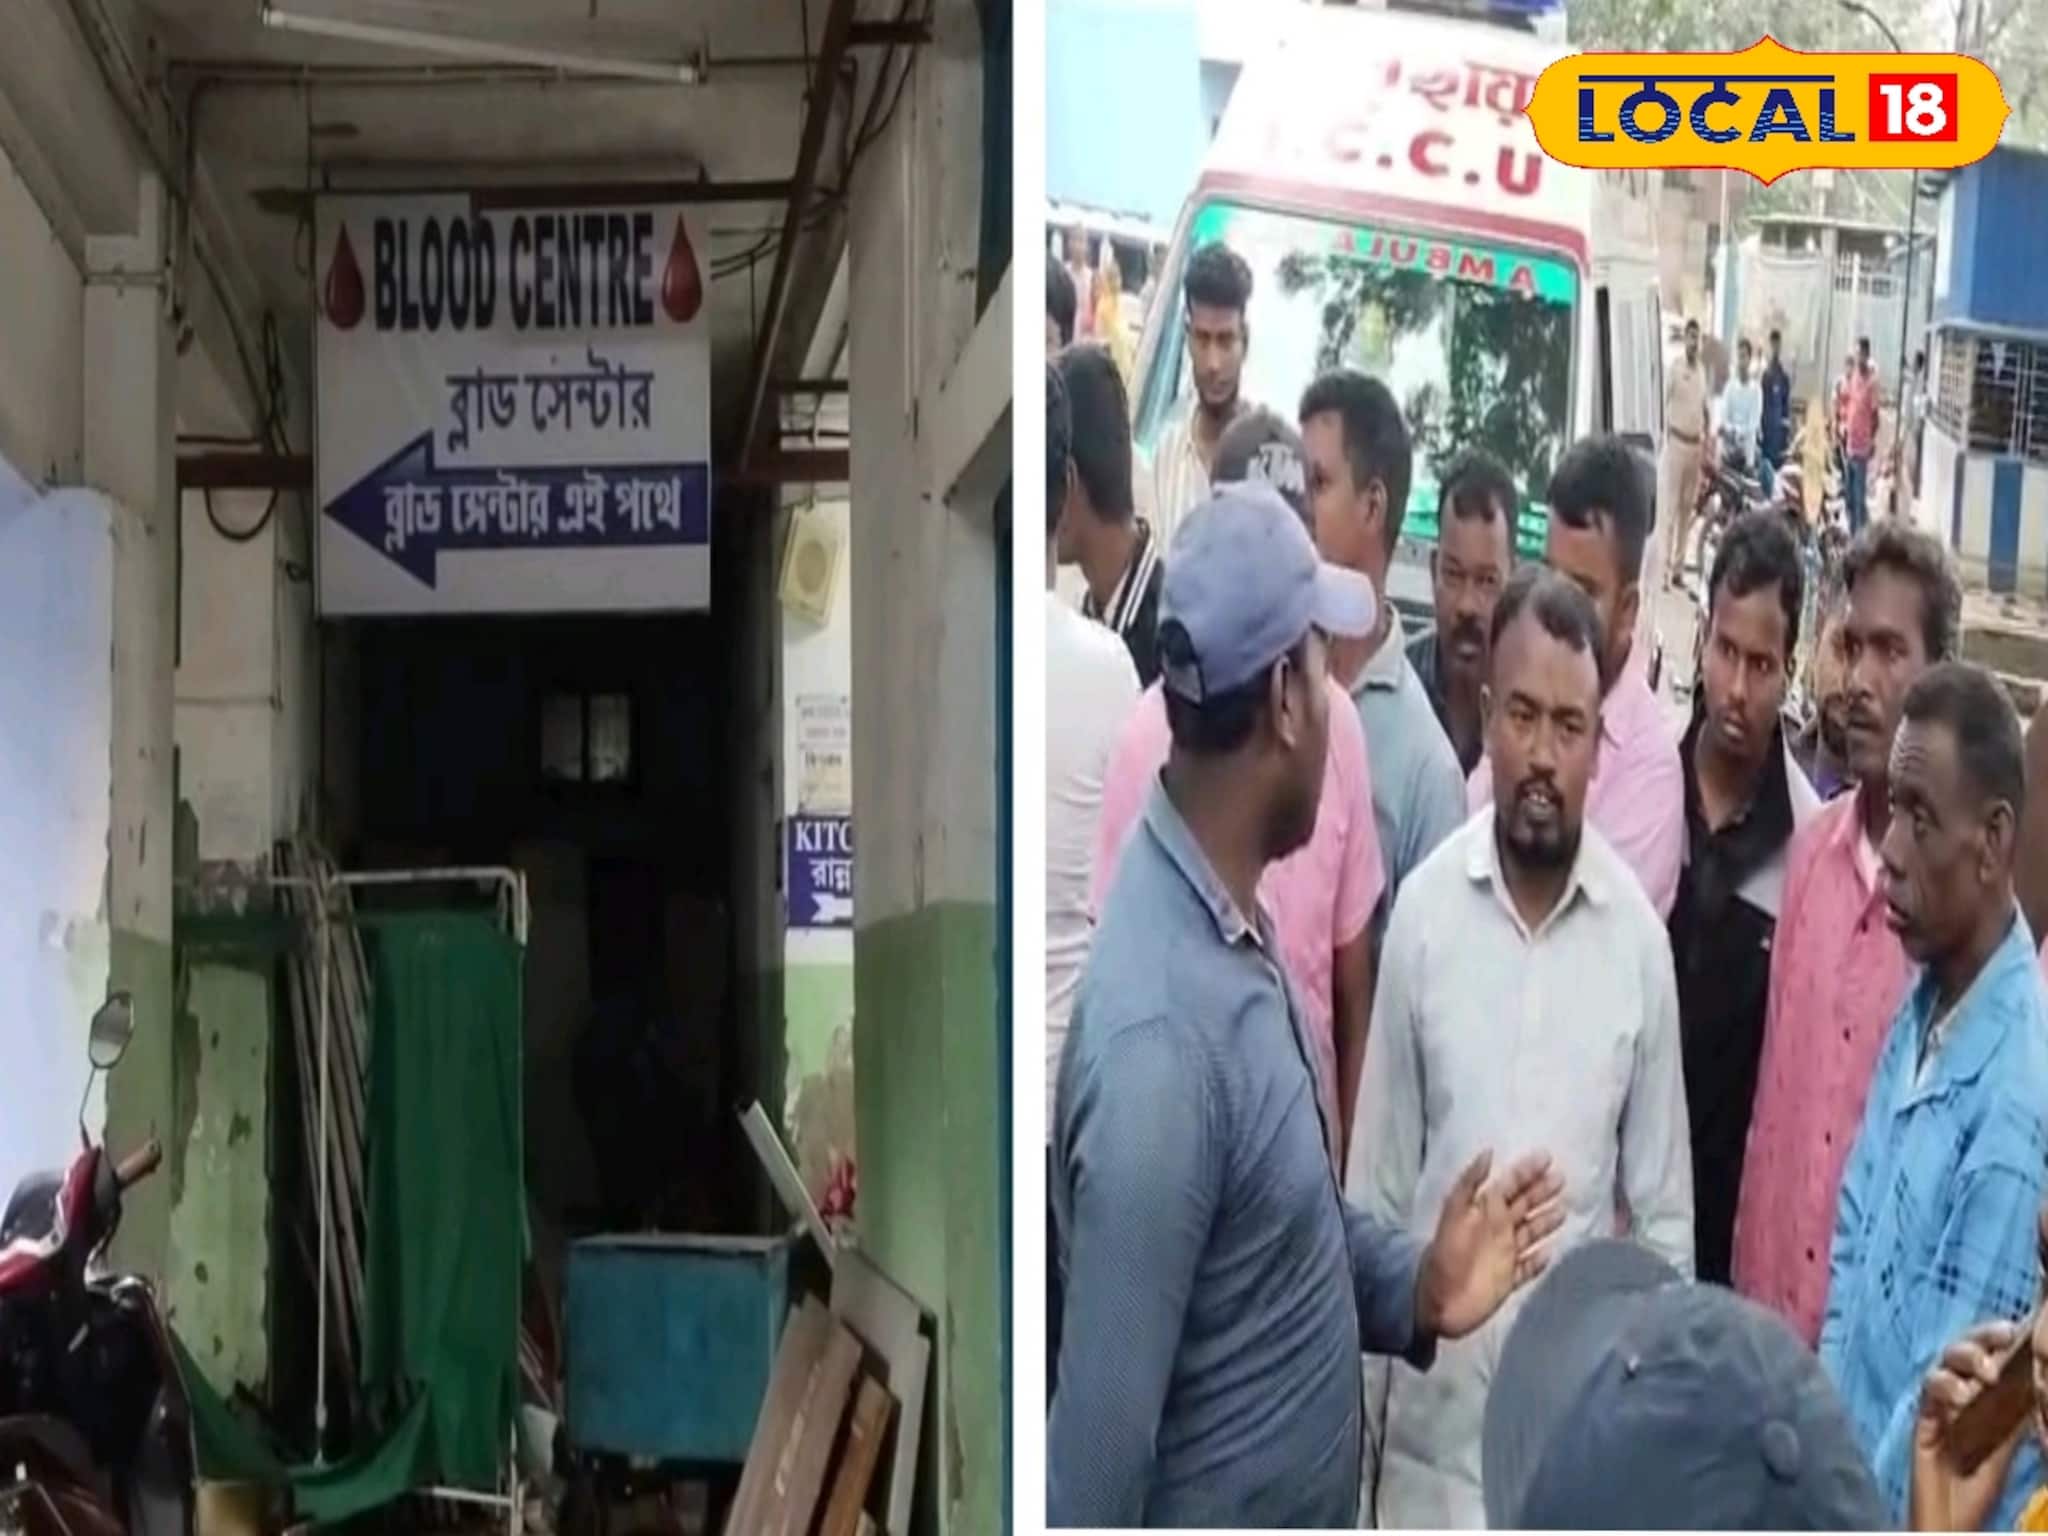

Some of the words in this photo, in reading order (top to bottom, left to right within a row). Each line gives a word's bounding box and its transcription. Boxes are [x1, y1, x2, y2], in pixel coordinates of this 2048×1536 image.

[374, 215, 496, 331] BLOOD
[508, 213, 654, 330] CENTRE
[446, 368, 519, 454] ব্লাড
[524, 346, 655, 433] সেন্টার
[384, 481, 442, 552] ব্লাড
[451, 468, 549, 538] সেন্টার
[557, 472, 608, 535] এই
[614, 476, 684, 532] পথে
